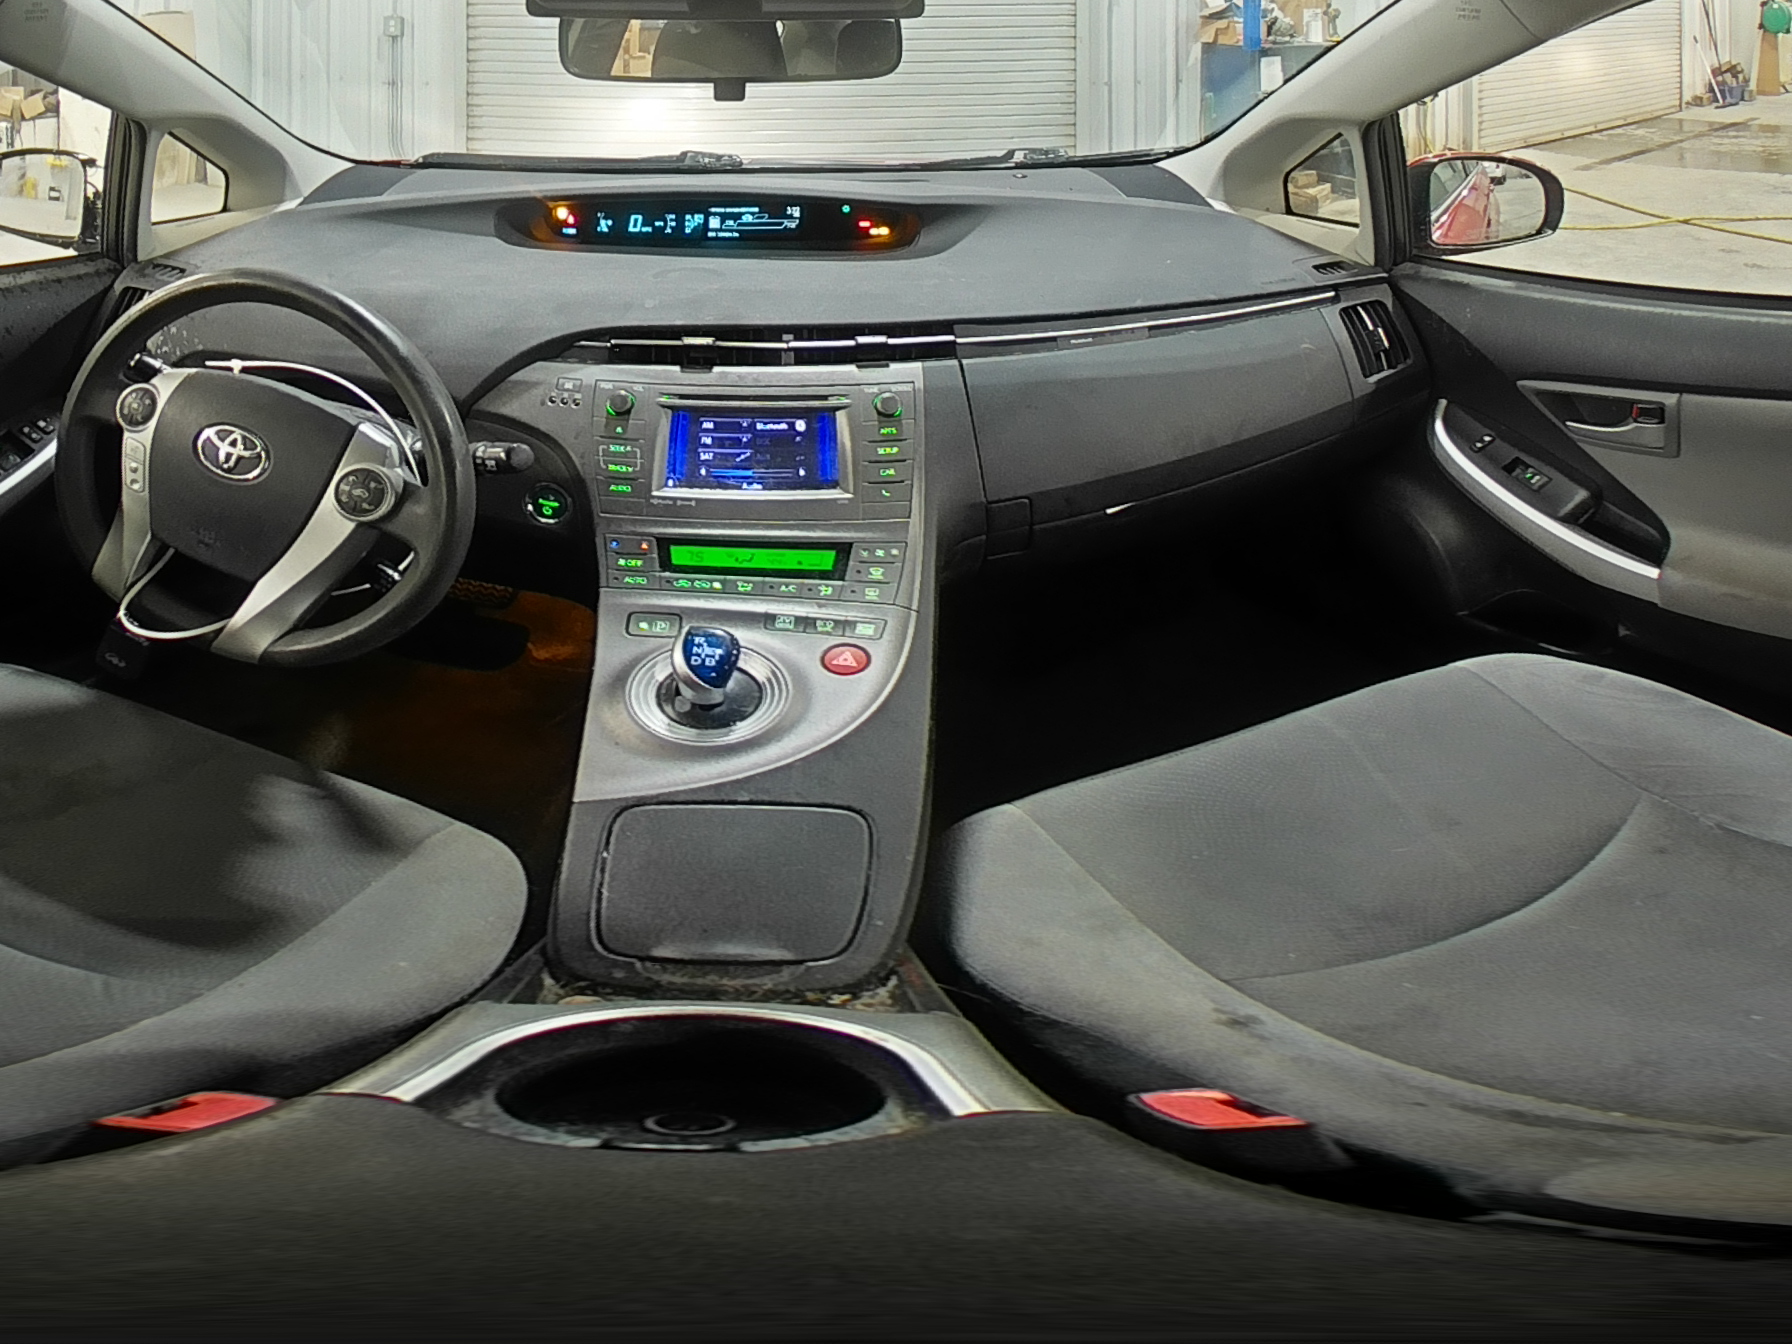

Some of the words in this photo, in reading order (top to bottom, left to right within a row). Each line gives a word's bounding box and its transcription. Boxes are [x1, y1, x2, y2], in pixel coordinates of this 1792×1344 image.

[701, 421, 714, 429] AM
[700, 436, 712, 445] FM
[699, 452, 714, 461] SAT
[626, 559, 645, 568] OFF
[623, 575, 648, 585] AUTO
[693, 636, 707, 645] R
[692, 645, 703, 655] N
[690, 656, 703, 666] D
[704, 657, 717, 667] B
